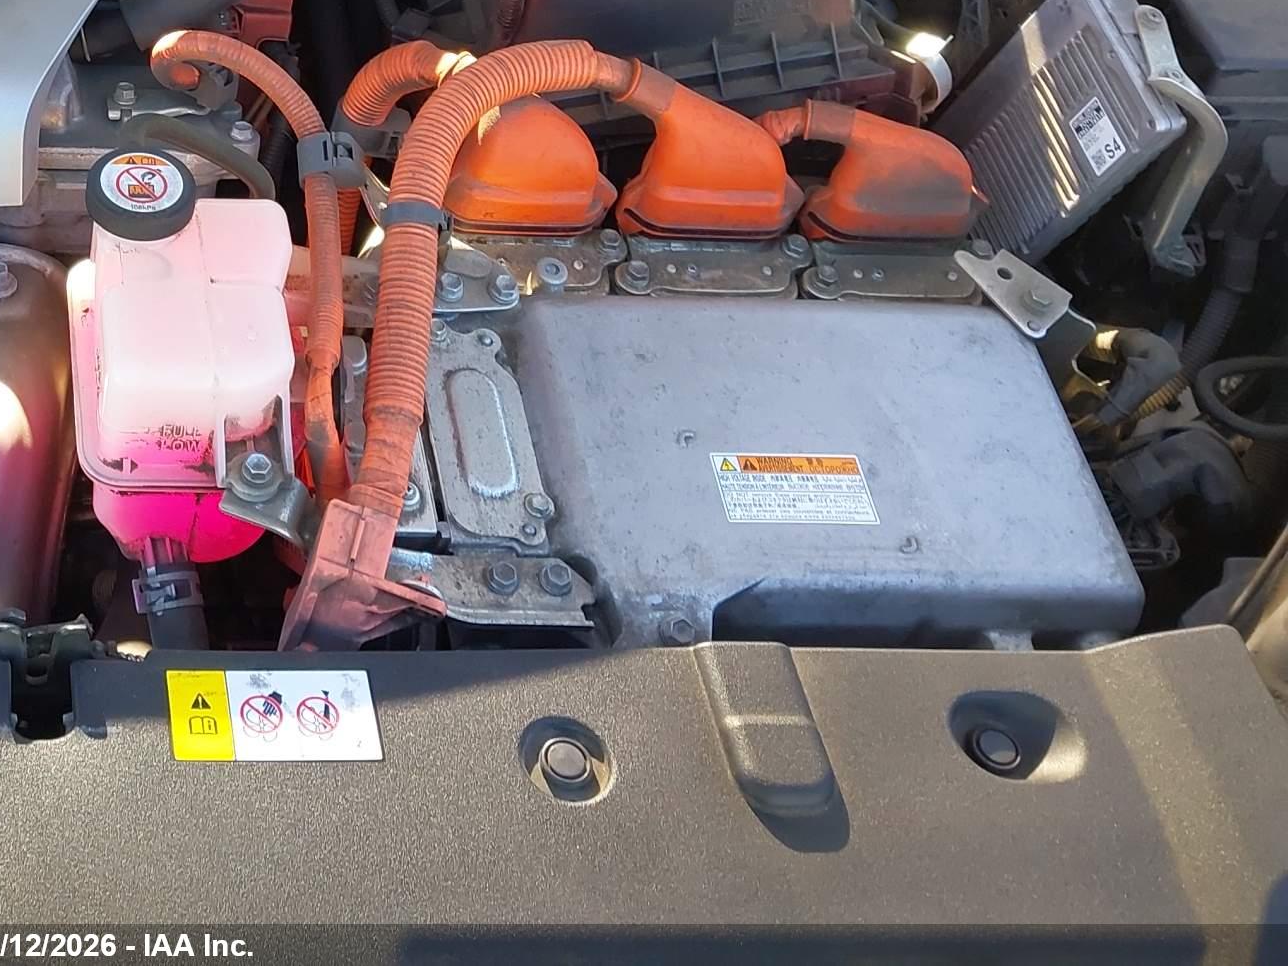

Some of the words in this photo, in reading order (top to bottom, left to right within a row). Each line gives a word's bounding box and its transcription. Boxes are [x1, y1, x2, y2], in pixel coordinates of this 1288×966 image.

[1104, 137, 1122, 159] S4
[159, 424, 201, 437] FULL
[157, 438, 200, 452] LOW
